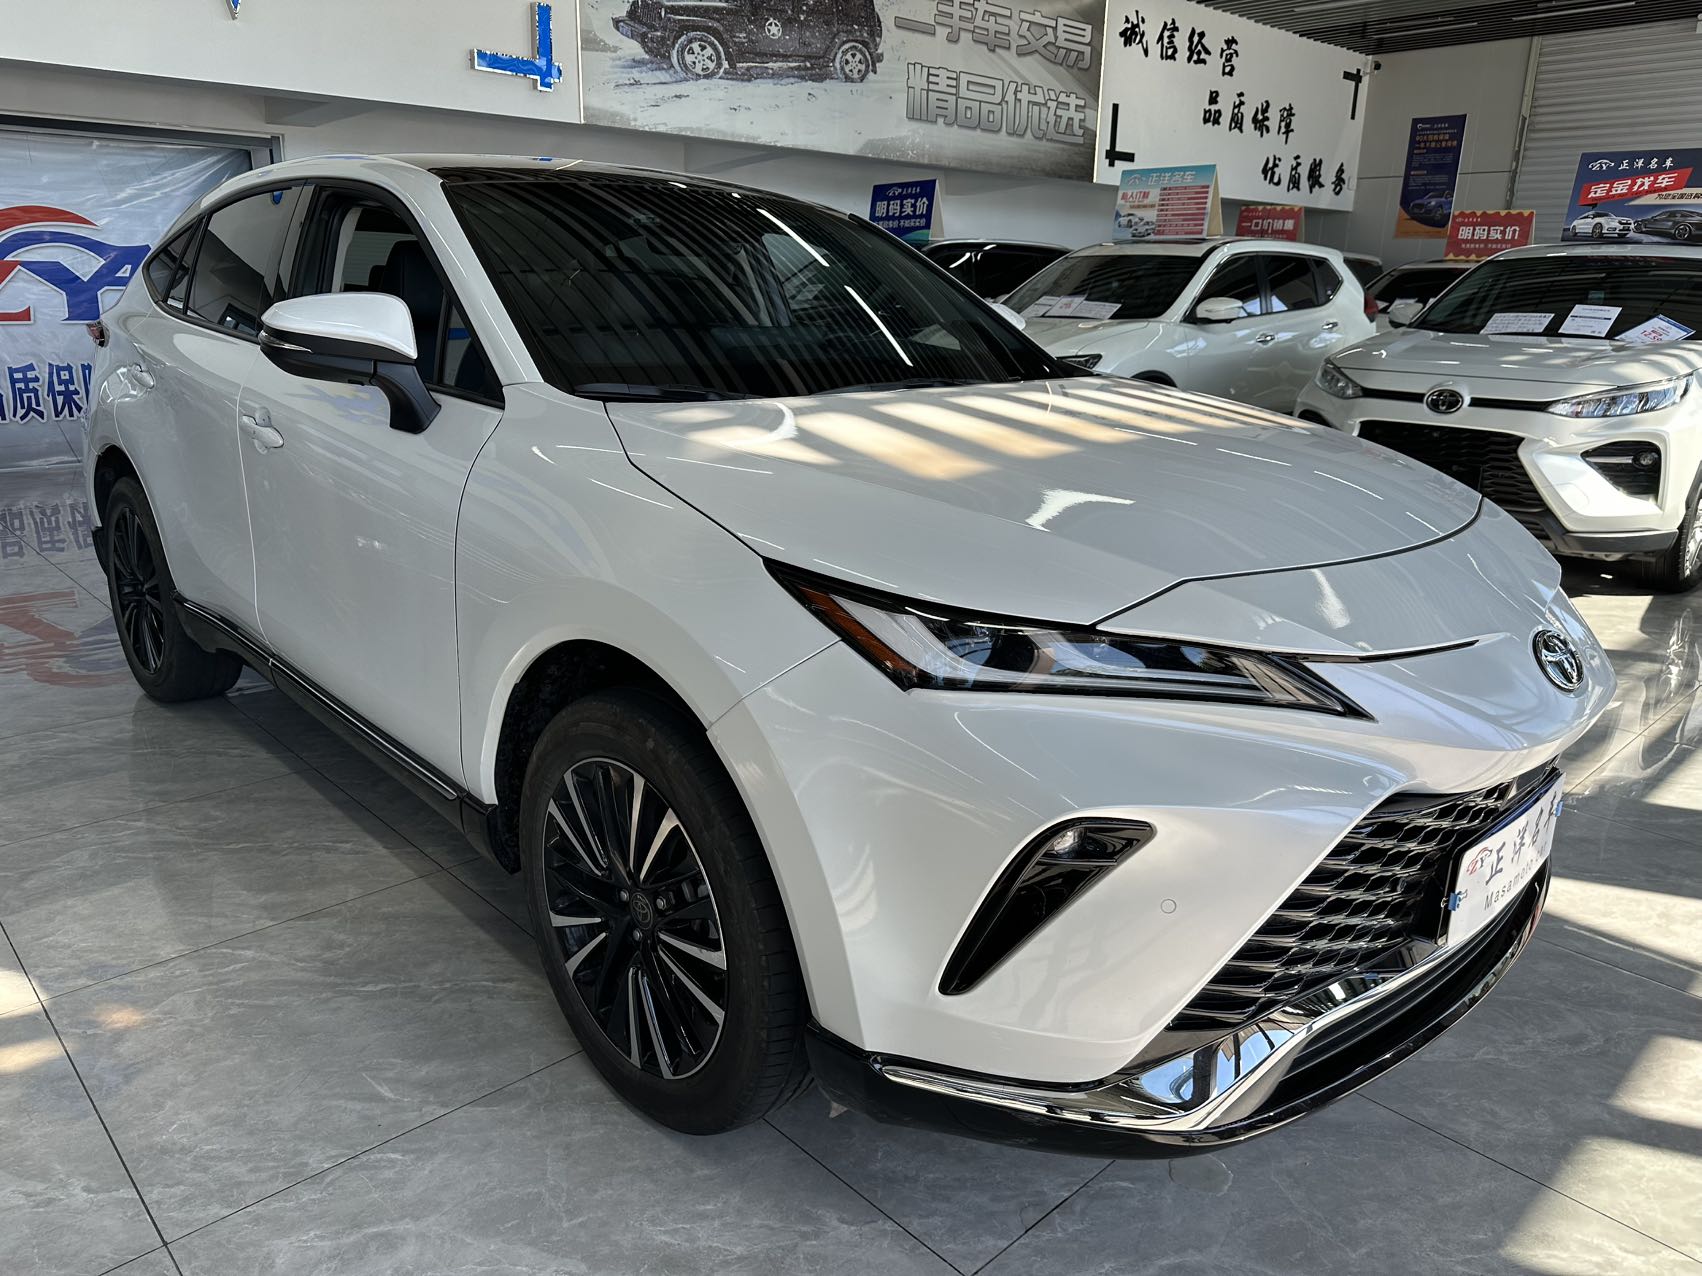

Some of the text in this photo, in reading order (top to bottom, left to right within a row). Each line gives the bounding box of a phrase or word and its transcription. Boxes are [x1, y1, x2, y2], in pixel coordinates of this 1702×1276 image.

[1119, 10, 1239, 77] 诚信经营
[906, 62, 1085, 144] 精品优选
[1203, 90, 1296, 145] 品质保障
[1262, 155, 1346, 196] 优质服务
[1618, 157, 1674, 170] 正洋名车
[1588, 174, 1678, 198] 定金找车
[875, 197, 929, 217] 明码实价
[1457, 225, 1520, 240] 明码实价
[0, 362, 92, 422] 质保
